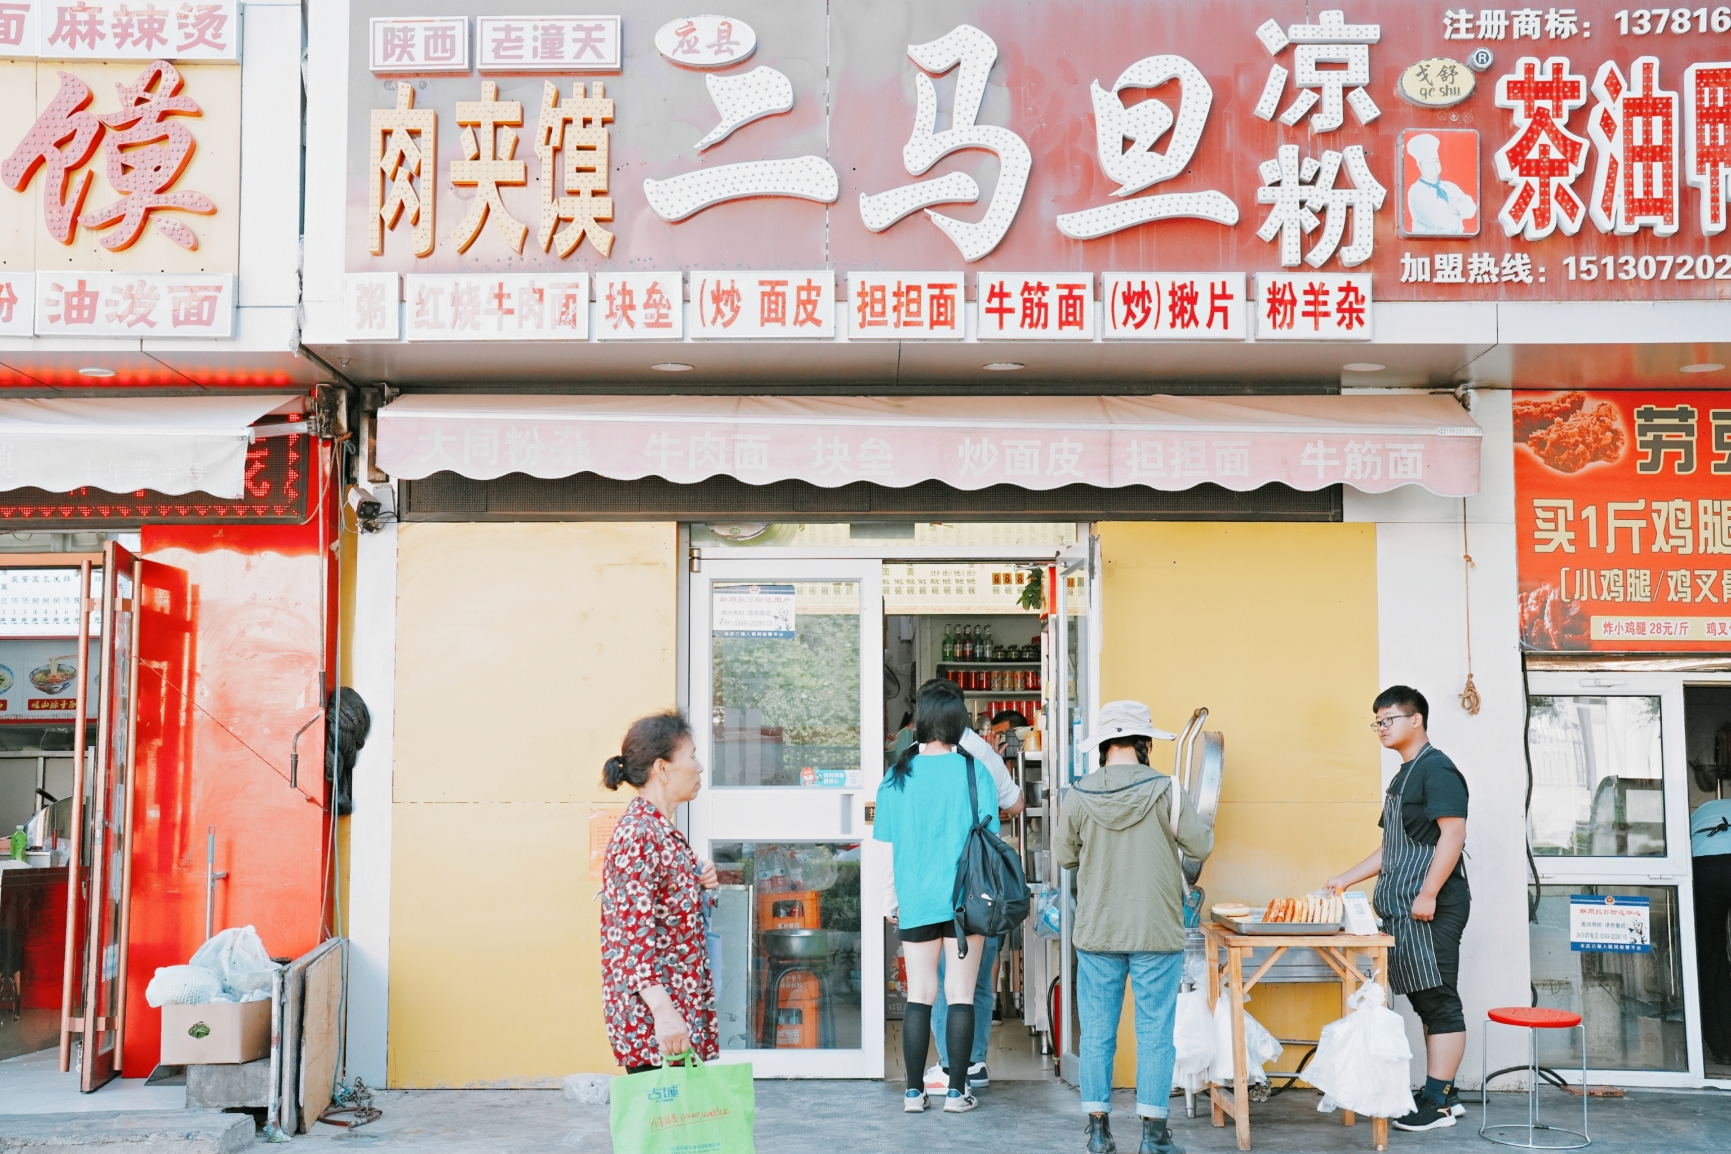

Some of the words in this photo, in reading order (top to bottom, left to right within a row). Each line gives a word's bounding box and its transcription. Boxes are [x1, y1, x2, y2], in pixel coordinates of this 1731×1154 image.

[48, 1, 229, 53] 麻辣烫
[382, 25, 456, 63] 陕西
[491, 23, 606, 62] 老潼关
[672, 20, 741, 57] 应县
[1614, 7, 1731, 35] 137816
[1415, 64, 1459, 87] 戈舒
[1419, 87, 1436, 100] ge
[1439, 84, 1462, 97] shu
[1254, 9, 1388, 269] 凉粉
[369, 80, 616, 259] 肉夹馍
[45, 279, 223, 328] 油泼面
[355, 281, 387, 330] 粥
[415, 280, 580, 331] 红烧牛肉面
[605, 280, 673, 330] 块垒
[856, 280, 957, 331] 担担面
[985, 280, 1086, 331] 牛筋面
[1266, 280, 1366, 332] 粉羊杂
[77, 459, 208, 483] 十年老字号
[418, 426, 591, 468] 大同粉杂
[644, 431, 772, 471] 牛肉面
[811, 436, 896, 476] 块垒
[958, 437, 1085, 478] 炒面皮
[1126, 438, 1251, 480] 担担面
[1301, 439, 1425, 481] 牛筋面
[1533, 499, 1731, 555] 买1斤鸡腿
[1602, 621, 1647, 636] 炸小鸡腿
[1650, 621, 1689, 636] 28元/斤
[1706, 622, 1731, 636] 鸡叉
